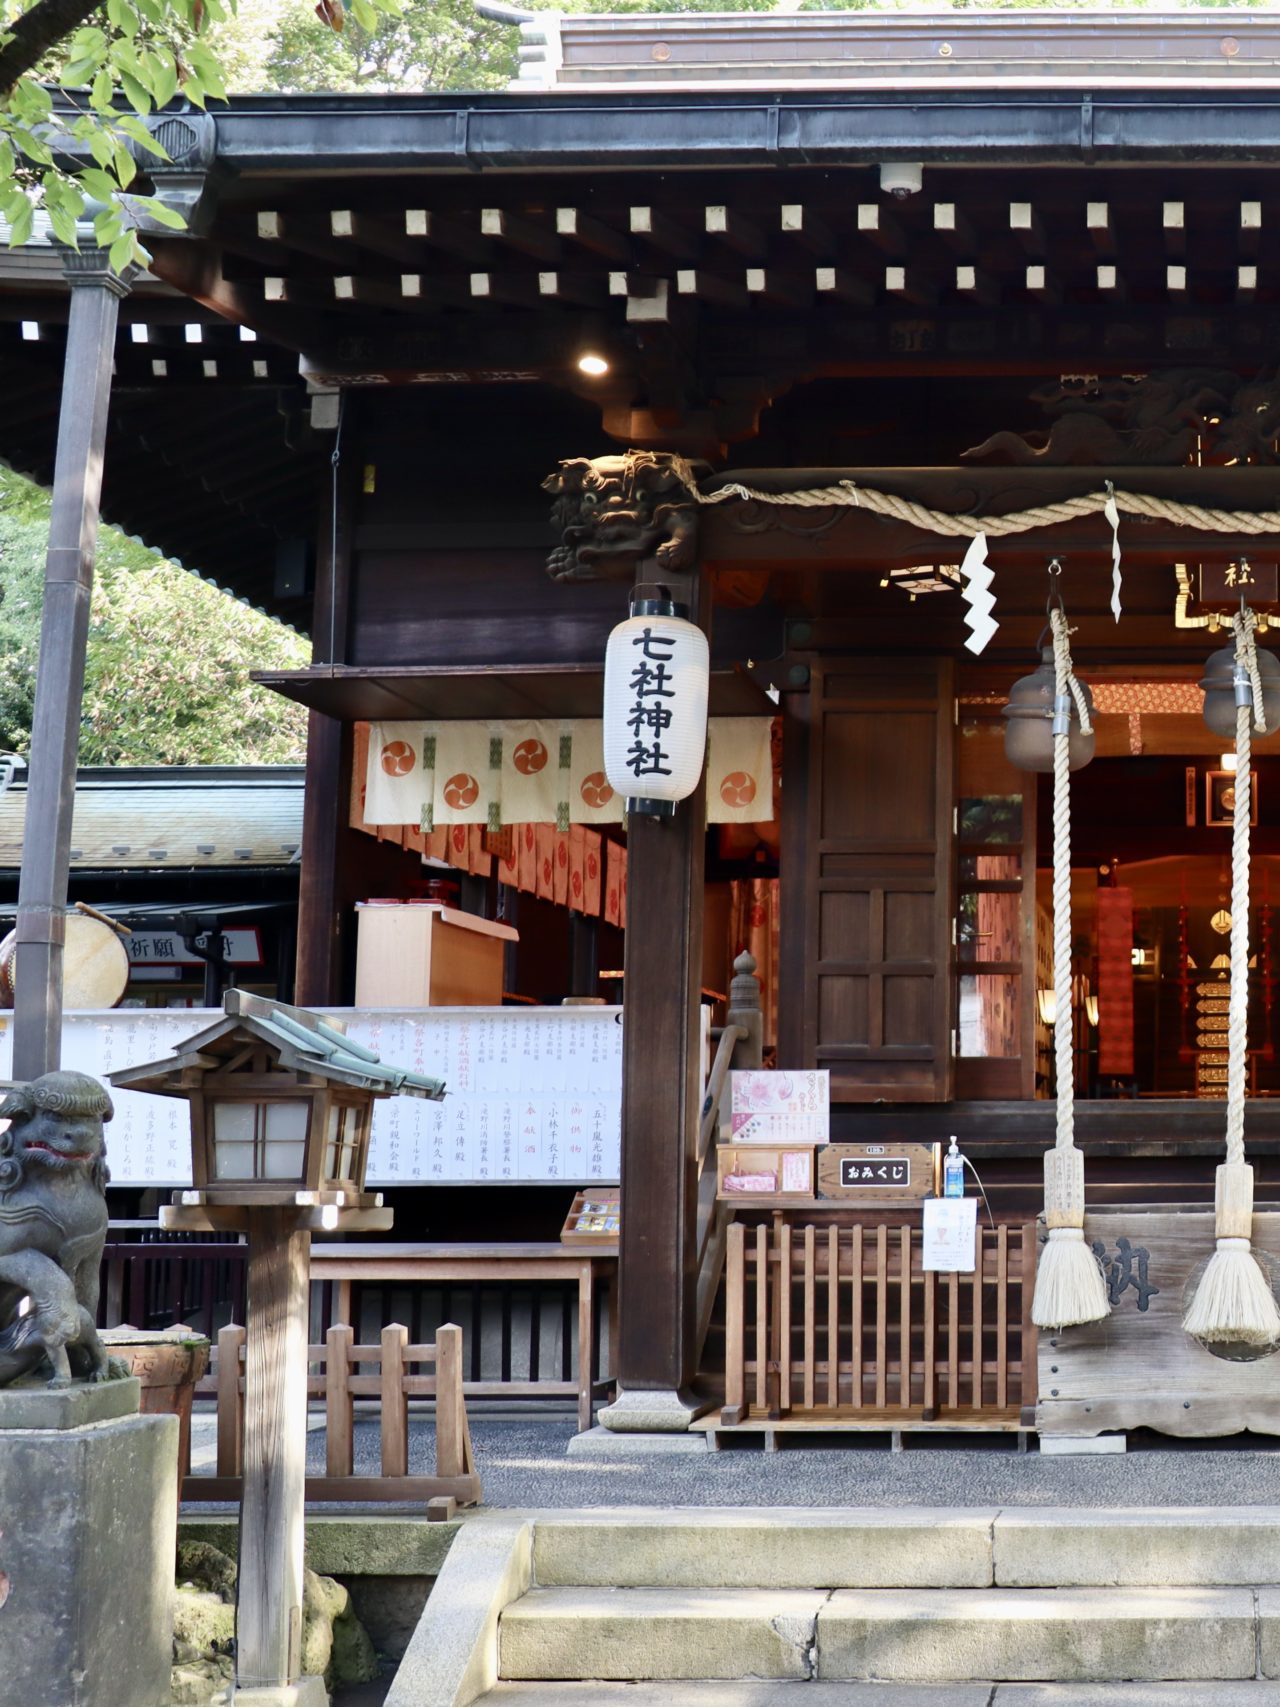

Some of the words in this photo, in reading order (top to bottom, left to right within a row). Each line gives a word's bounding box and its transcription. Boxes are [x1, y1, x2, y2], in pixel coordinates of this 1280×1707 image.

[626, 627, 676, 777] 七社神社
[847, 1165, 905, 1180] おみくじ
